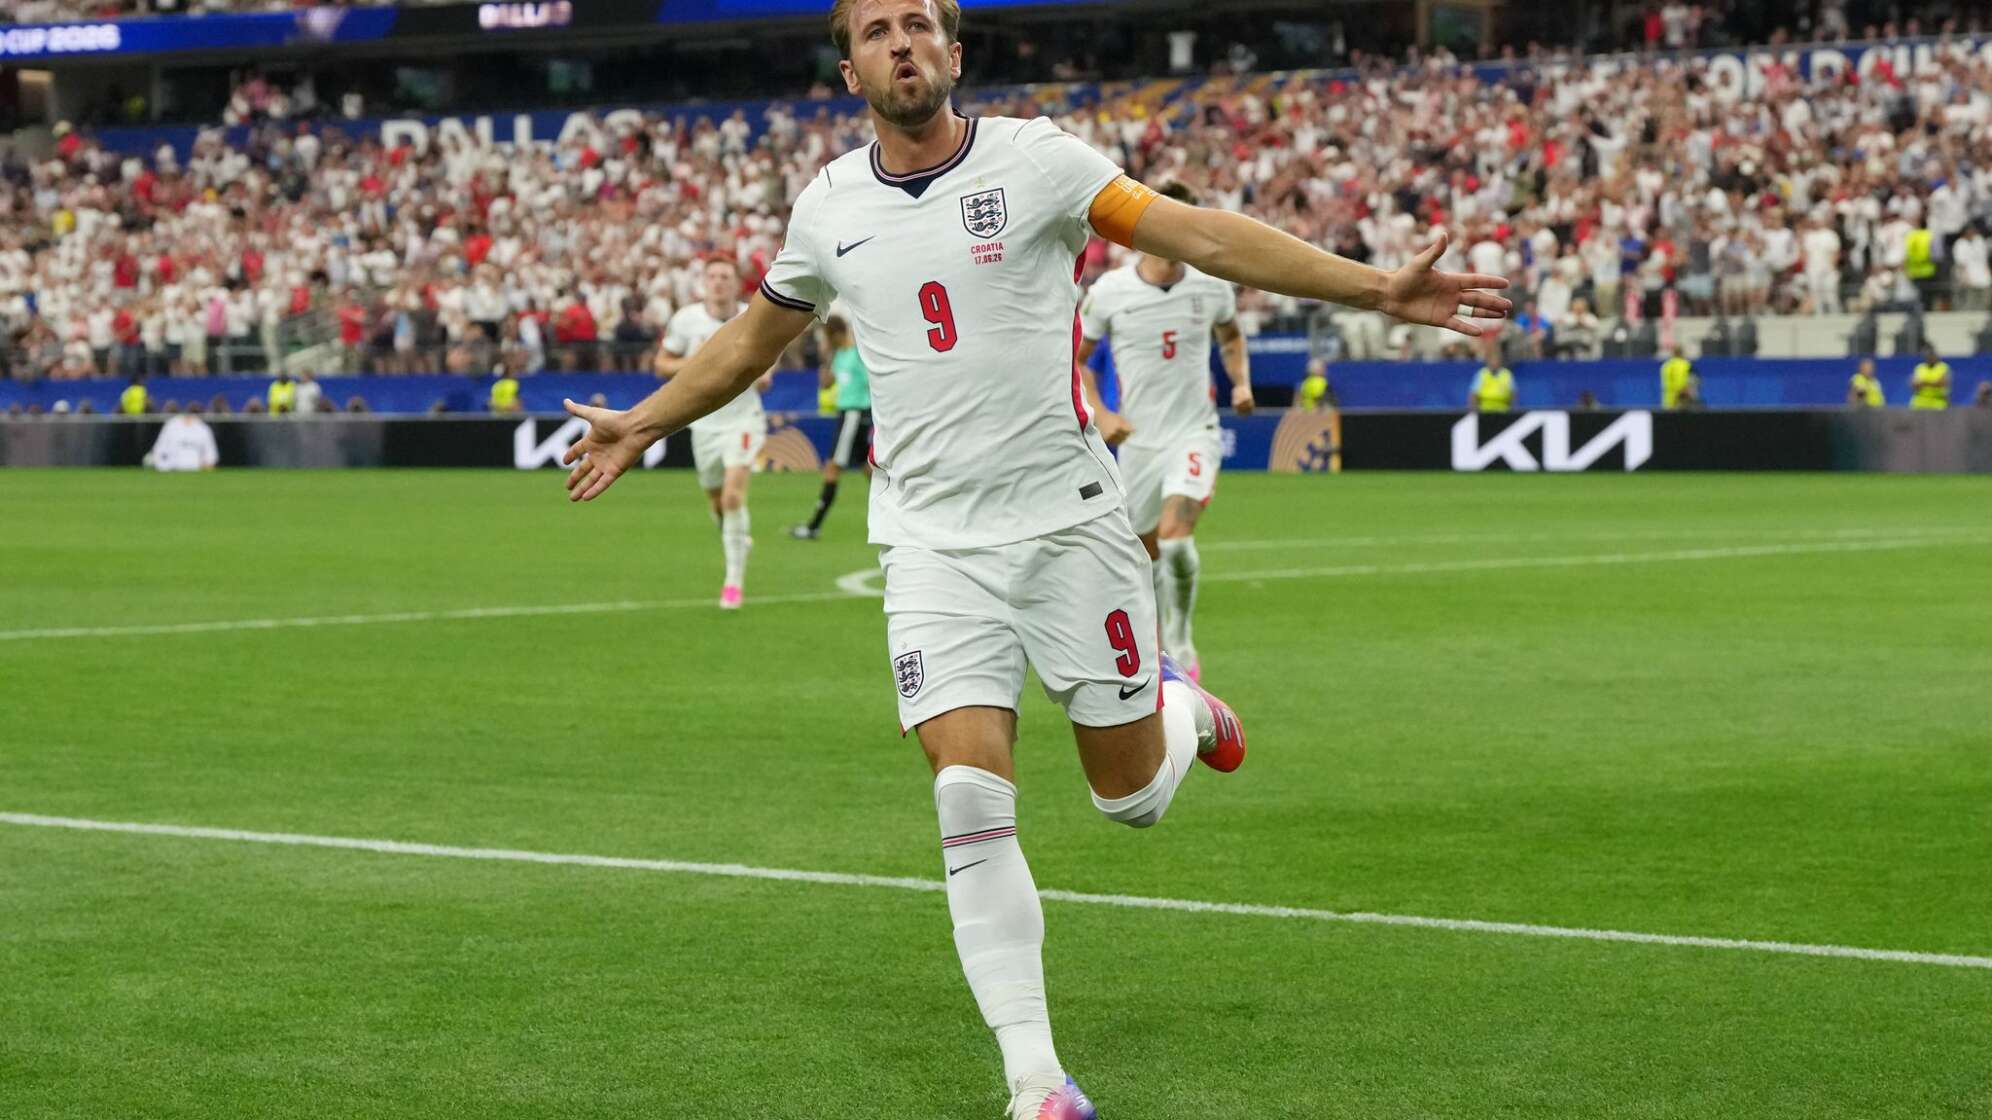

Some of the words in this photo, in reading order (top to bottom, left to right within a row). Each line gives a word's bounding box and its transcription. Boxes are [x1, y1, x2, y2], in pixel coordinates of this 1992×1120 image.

[970, 242, 1004, 255] CROATIA
[974, 253, 1003, 265] 17.06.26
[918, 280, 958, 352] 9
[1161, 330, 1178, 360] 5
[1188, 452, 1201, 477] 5
[1104, 608, 1141, 678] 9
